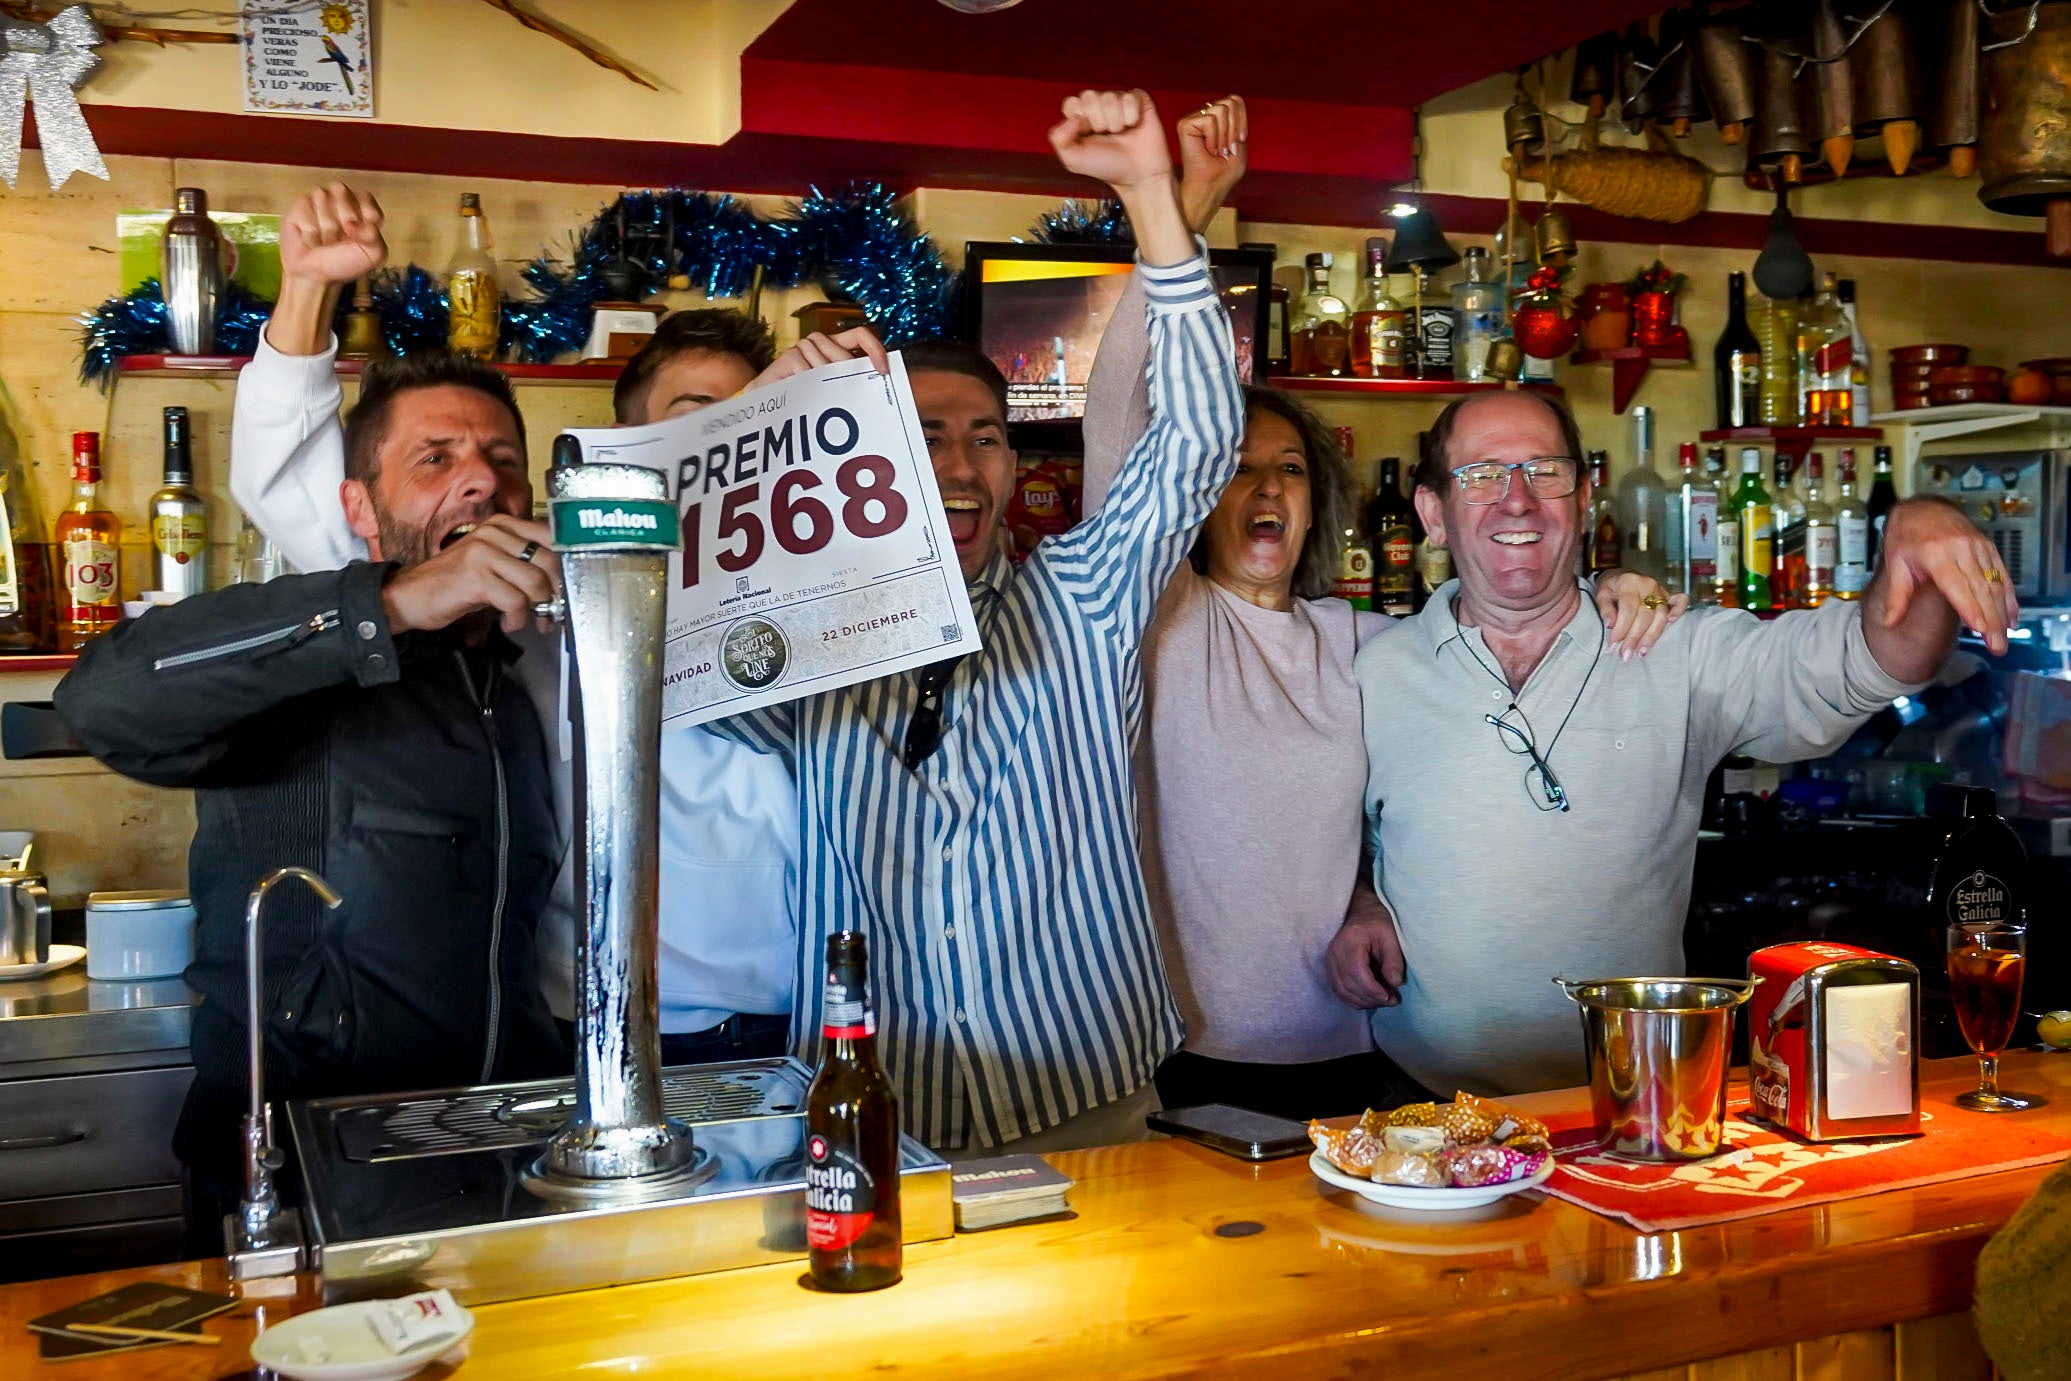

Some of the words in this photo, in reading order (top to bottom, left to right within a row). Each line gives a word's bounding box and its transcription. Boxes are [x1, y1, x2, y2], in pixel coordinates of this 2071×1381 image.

[263, 47, 298, 57] COMO
[266, 69, 309, 78] ALGUNO
[259, 79, 268, 89] Y
[271, 80, 288, 90] LO
[677, 407, 860, 504] PREMIO
[577, 507, 658, 530] Mahou
[69, 562, 115, 588] 103
[742, 587, 772, 600] Nacional
[673, 625, 689, 635] HAY
[689, 613, 716, 628] MAYOR
[717, 605, 747, 620] SUERTE
[748, 599, 768, 610] QUE
[769, 595, 781, 606] LA
[783, 592, 794, 602] DE
[796, 580, 847, 598] TENERNOS
[822, 630, 839, 642] 22
[842, 608, 918, 637] DICIEMBRE
[1956, 887, 2003, 905] Estrella
[1959, 903, 2001, 921] Galicia
[952, 1167, 1037, 1183] Mahou
